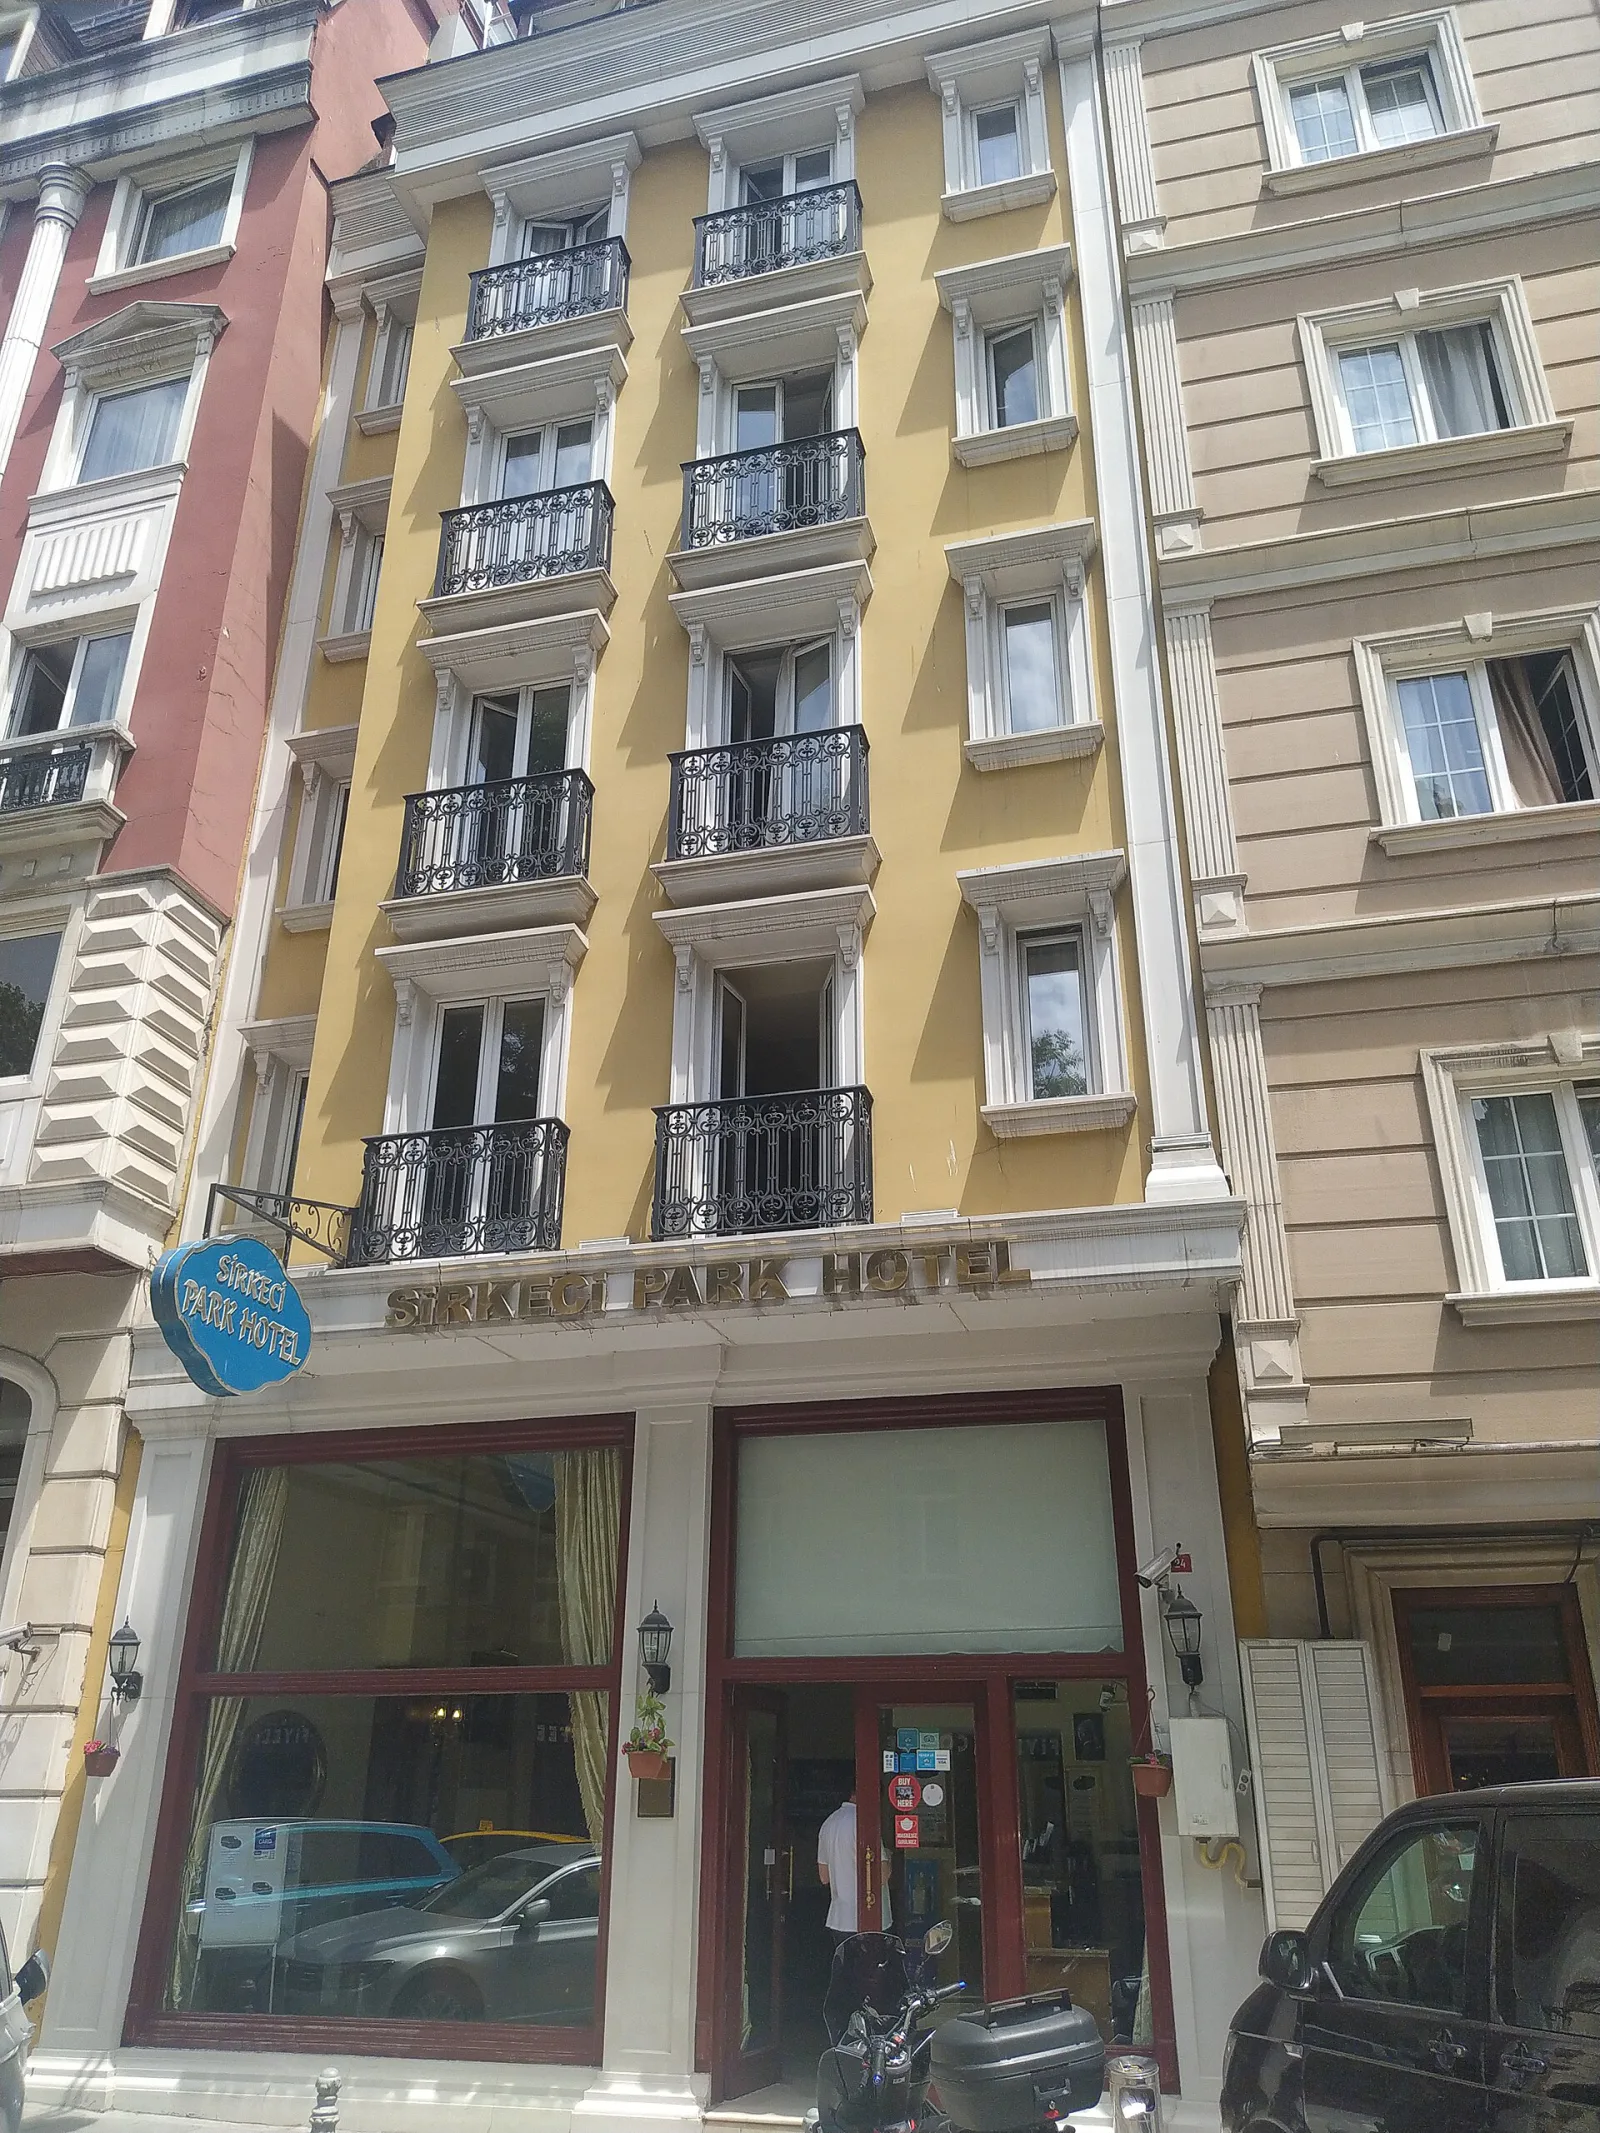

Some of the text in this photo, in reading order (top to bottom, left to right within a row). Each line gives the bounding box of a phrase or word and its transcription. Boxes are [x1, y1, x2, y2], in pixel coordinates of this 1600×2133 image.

[216, 1254, 287, 1313] SİRKECİ
[384, 1241, 1031, 1328] SİRKECİ PARK HOTEL
[182, 1279, 302, 1366] PARK HOTEL
[897, 1799, 913, 1807] HERE
[898, 1777, 911, 1786] BUY
